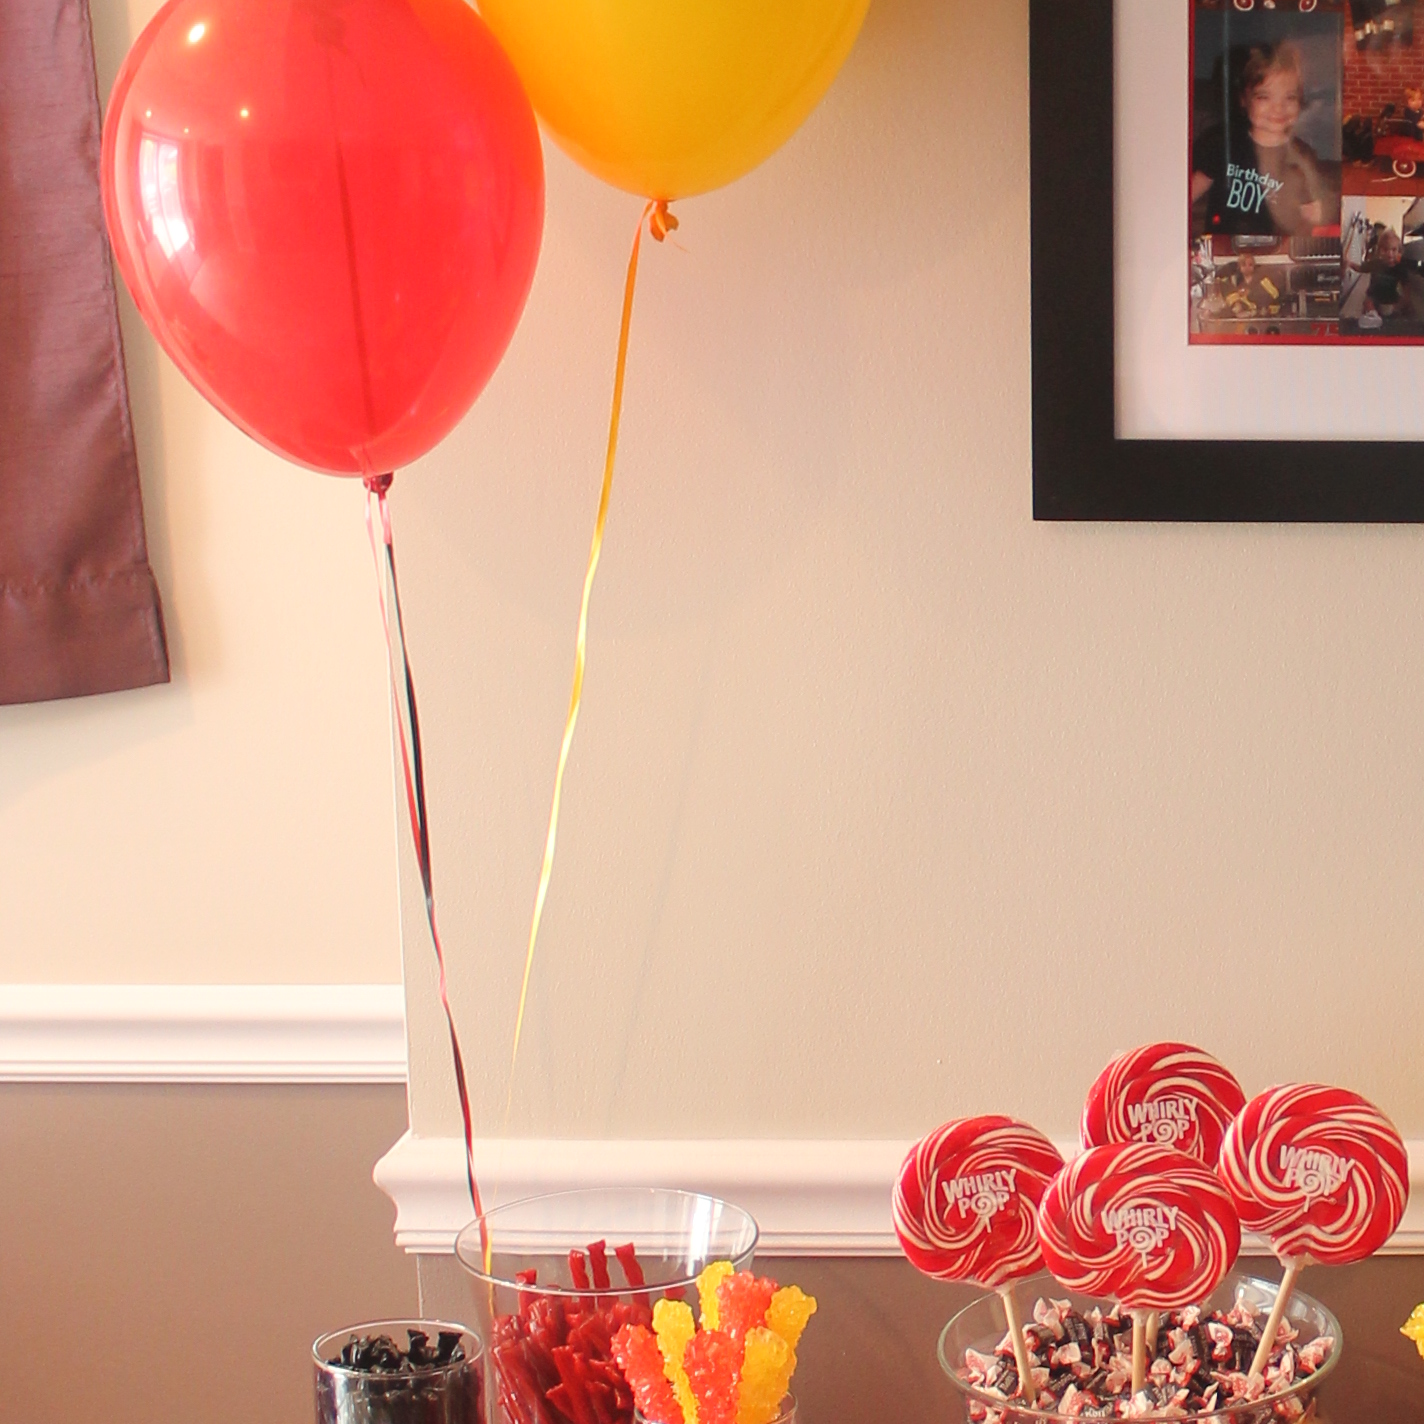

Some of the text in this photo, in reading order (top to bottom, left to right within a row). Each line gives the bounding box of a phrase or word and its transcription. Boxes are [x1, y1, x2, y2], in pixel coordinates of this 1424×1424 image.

[1226, 163, 1285, 193] Birthday
[1226, 178, 1271, 214] BOY
[1128, 1097, 1198, 1128] WHIRLY
[1140, 1119, 1190, 1145] POP
[1280, 1144, 1356, 1183] WHIRLY
[941, 1168, 1017, 1204] WHIRLY
[1285, 1167, 1341, 1196] POP
[958, 1191, 1010, 1219] POP
[1101, 1205, 1179, 1234] WHIRLY
[1116, 1226, 1169, 1253] POP
